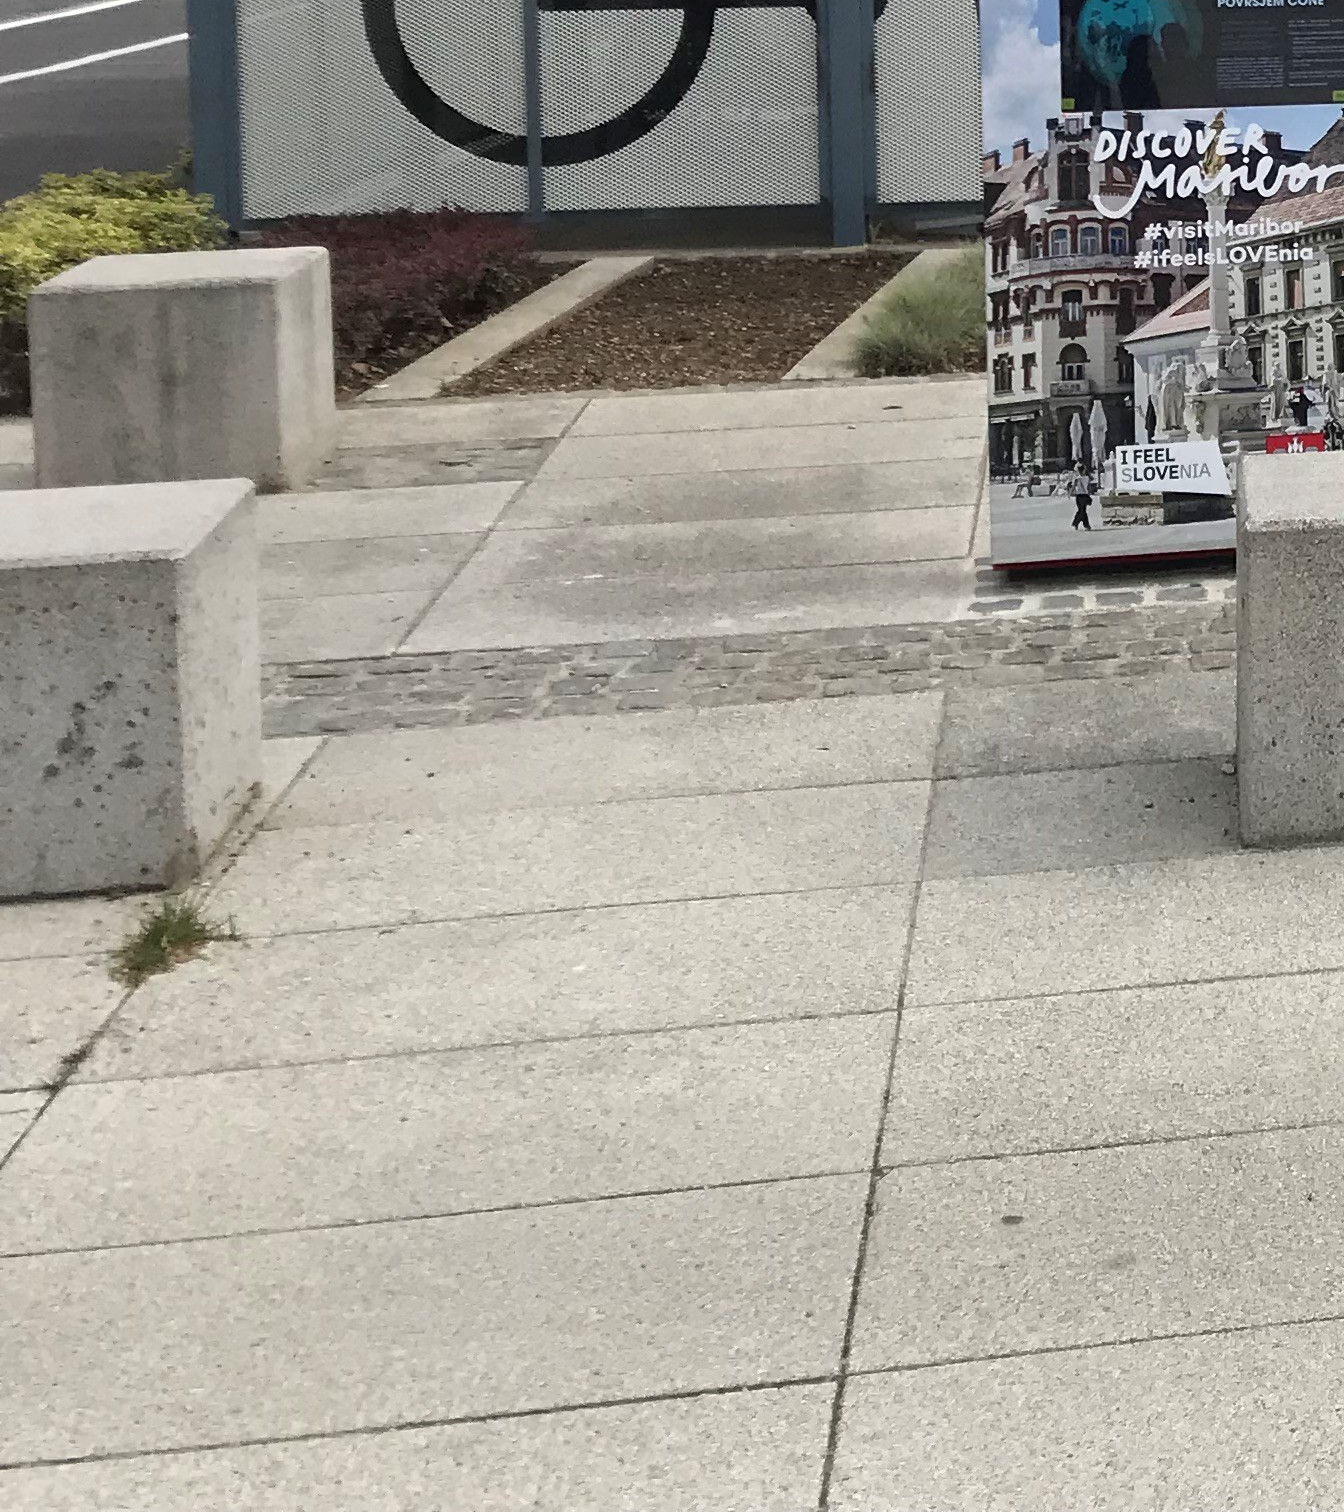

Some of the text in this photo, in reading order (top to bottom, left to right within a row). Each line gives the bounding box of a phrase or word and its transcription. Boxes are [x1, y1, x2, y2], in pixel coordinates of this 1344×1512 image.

[1093, 122, 1269, 162] DISCOVER
[1143, 217, 1304, 241] #visitMaribor
[1134, 243, 1313, 268] #ifeelsLOVEnia
[1120, 447, 1176, 465] I FEEL
[1121, 463, 1212, 483] SLOVENIA
